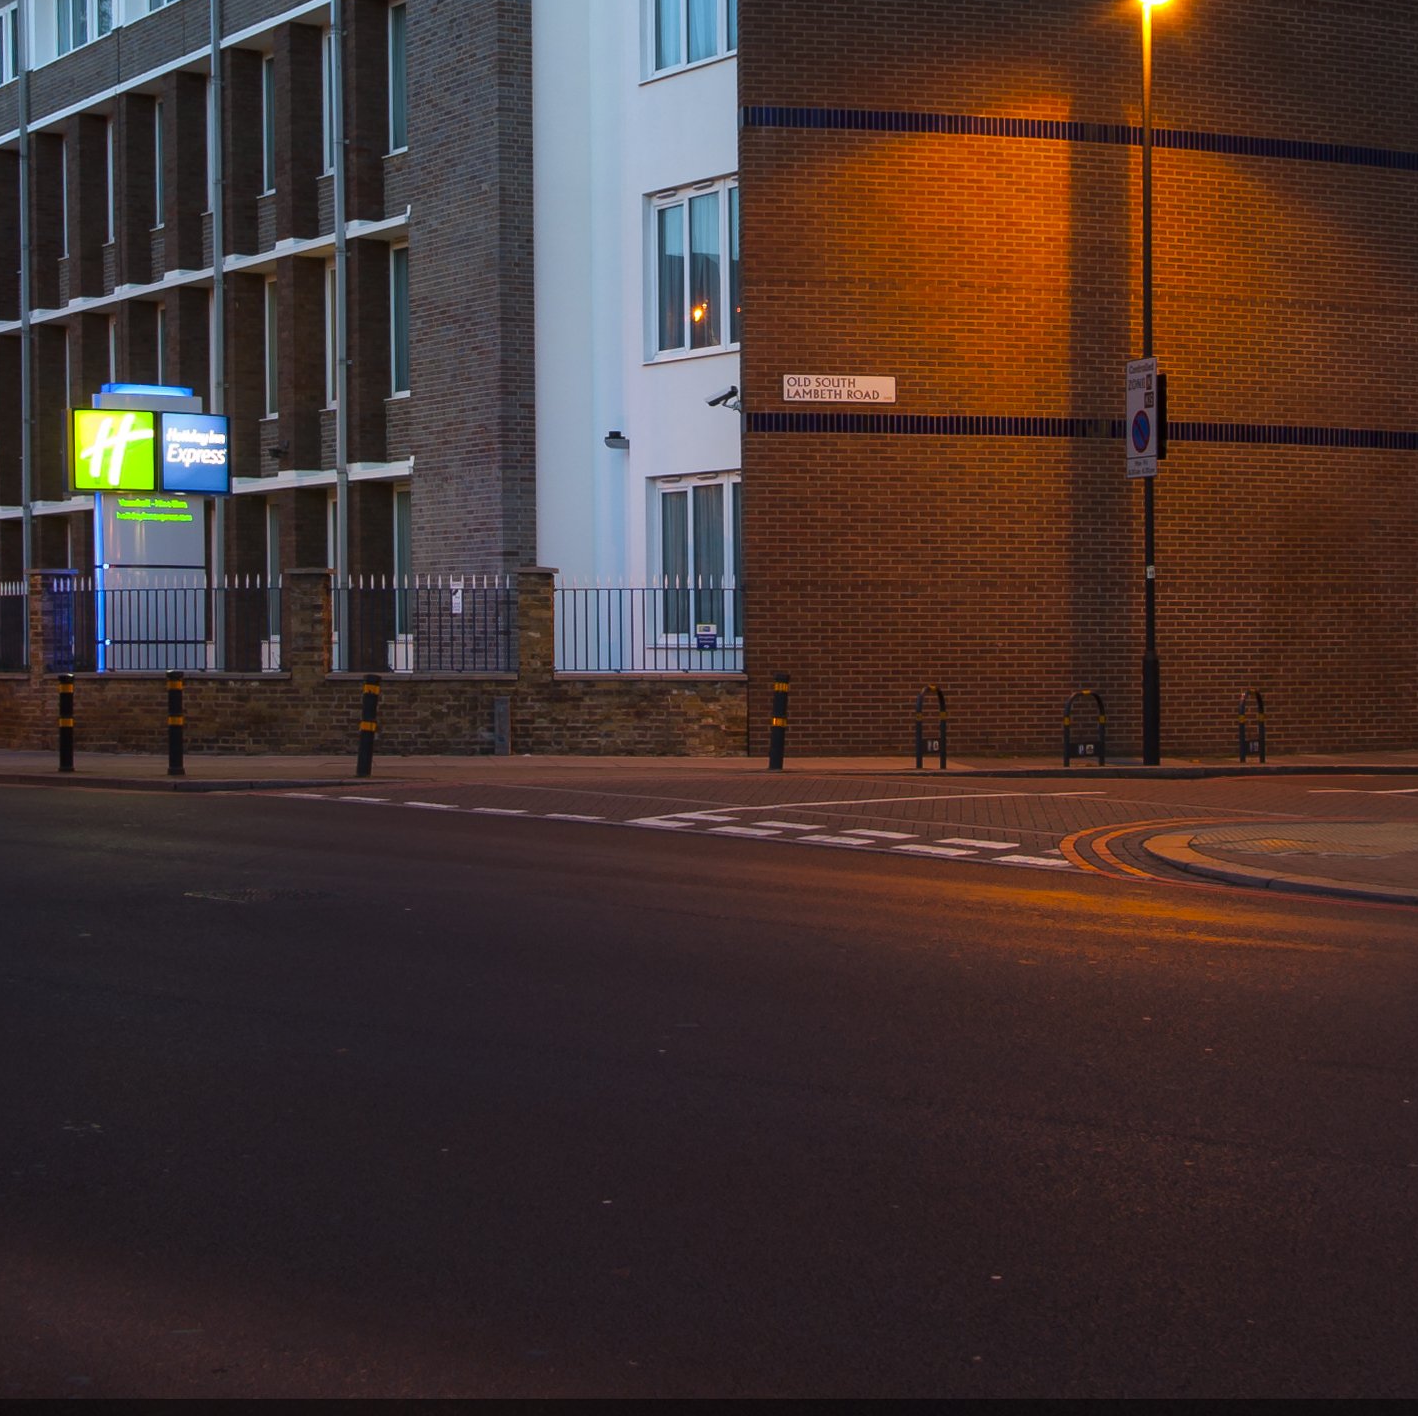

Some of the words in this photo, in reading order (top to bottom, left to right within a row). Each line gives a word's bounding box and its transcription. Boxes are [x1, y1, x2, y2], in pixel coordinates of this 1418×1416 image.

[787, 377, 811, 387] OLD
[815, 377, 856, 388] SOUTH
[787, 388, 842, 399] LAMBETH
[847, 389, 880, 400] ROAD
[167, 443, 226, 467] Express
